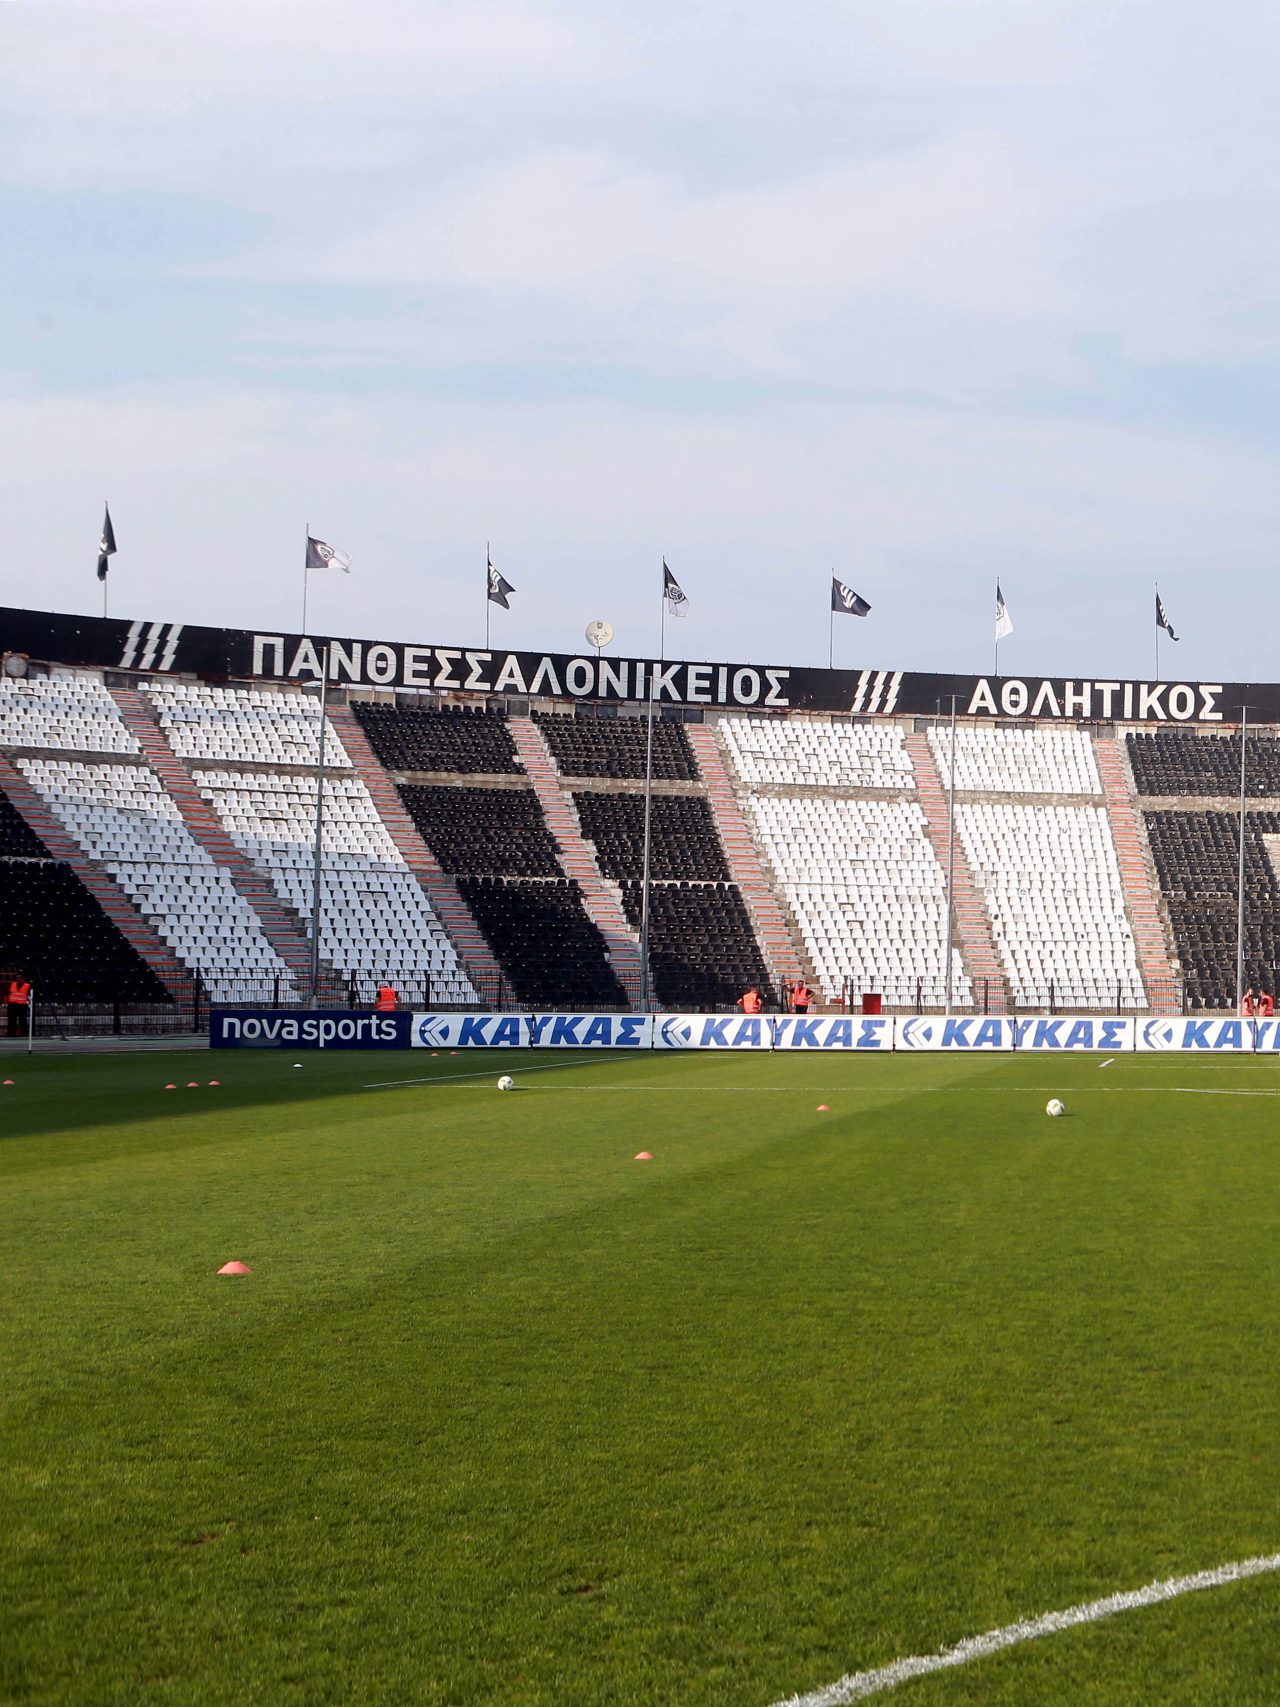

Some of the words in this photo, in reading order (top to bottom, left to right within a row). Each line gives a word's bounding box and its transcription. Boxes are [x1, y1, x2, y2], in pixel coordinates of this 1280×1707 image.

[253, 635, 790, 706] ΠΑΝΘΕΣΣΑΛΟΝΙΚΕΙΟΣ
[967, 678, 1224, 721] ΑΘΛΗΤΙΚΟΣ
[222, 1014, 398, 1048] novasports
[457, 1016, 646, 1046] ΚΑΥΚΑΣ
[699, 1017, 888, 1048] ΚΑΥΚΑΣ
[940, 1017, 1128, 1049] ΚΑΥΚΑΣ
